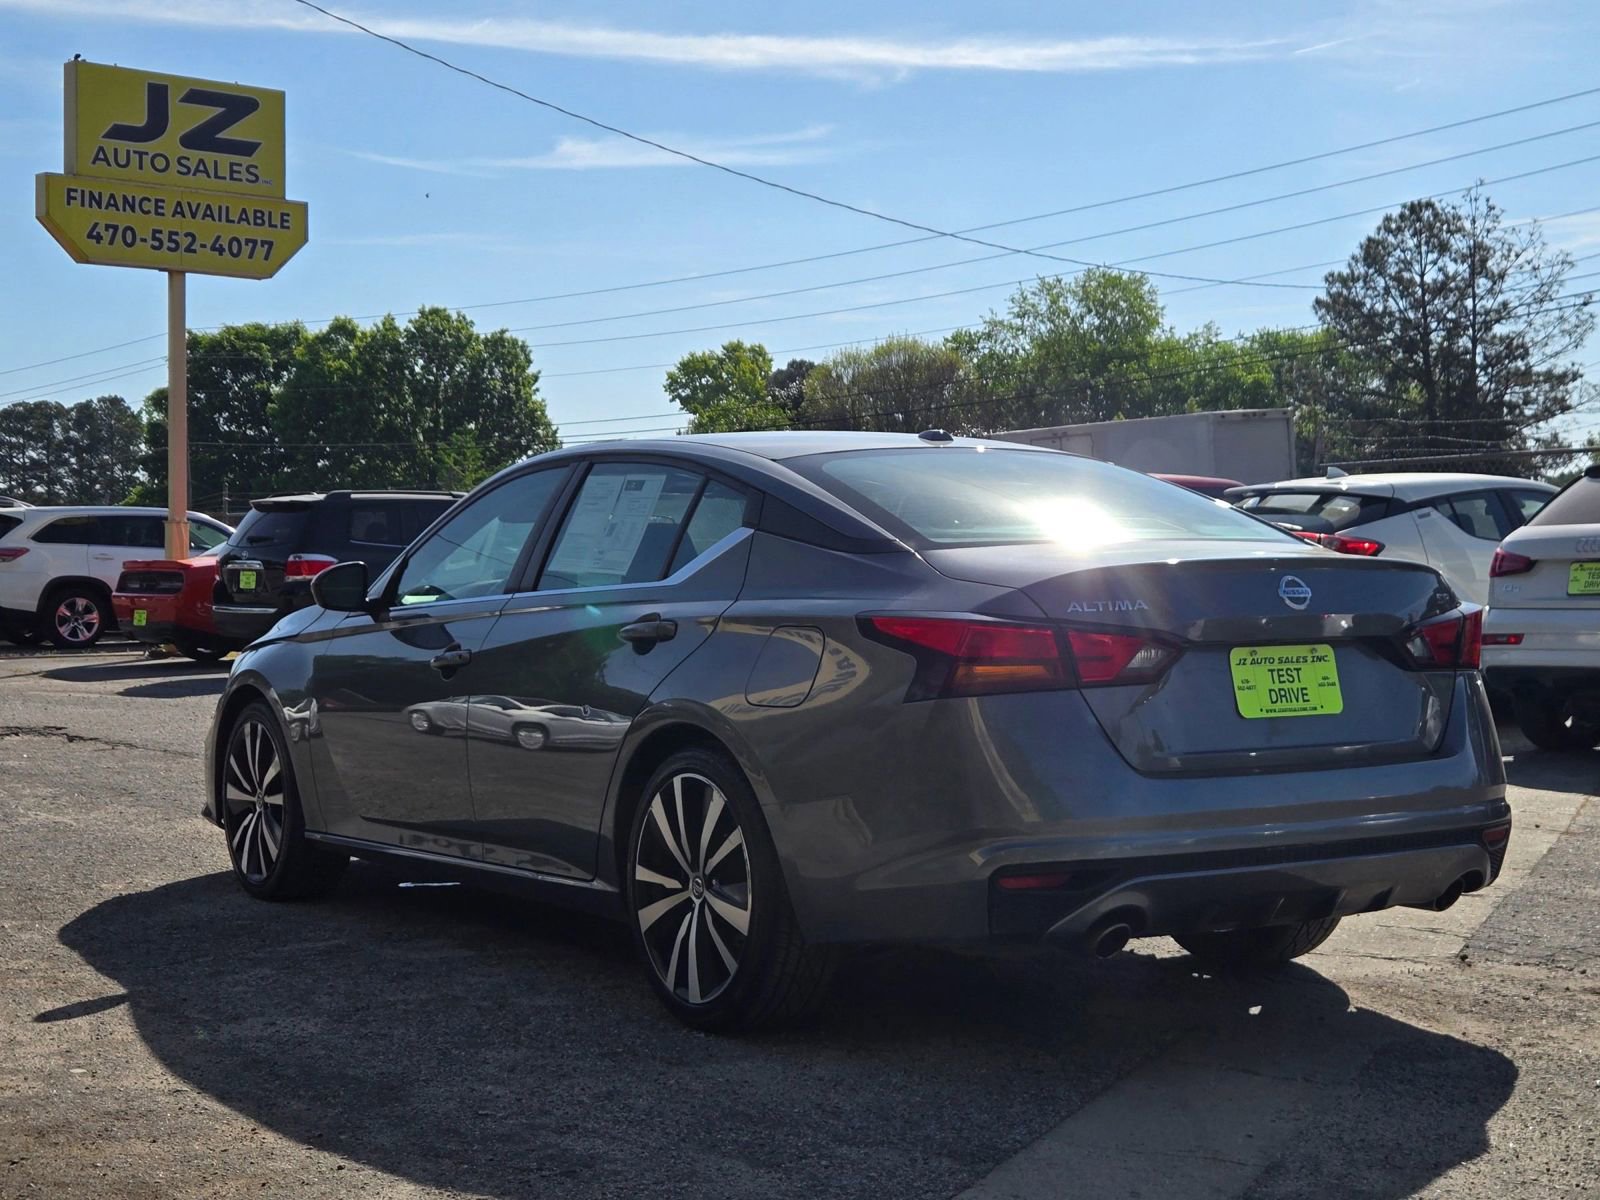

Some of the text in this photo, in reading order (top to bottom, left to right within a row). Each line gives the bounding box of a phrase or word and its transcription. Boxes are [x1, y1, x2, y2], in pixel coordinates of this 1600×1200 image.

[101, 82, 262, 157] JZ
[91, 145, 170, 173] AUTO
[176, 155, 260, 184] SALES
[65, 188, 291, 230] FINANCE AVAILABLE
[86, 222, 274, 261] 470-552-4077
[1067, 600, 1149, 613] ALTIMA
[1235, 654, 1330, 666] JZ AUTO SALES INC.
[1267, 667, 1302, 684] TEST
[1268, 687, 1310, 704] DRIVE
